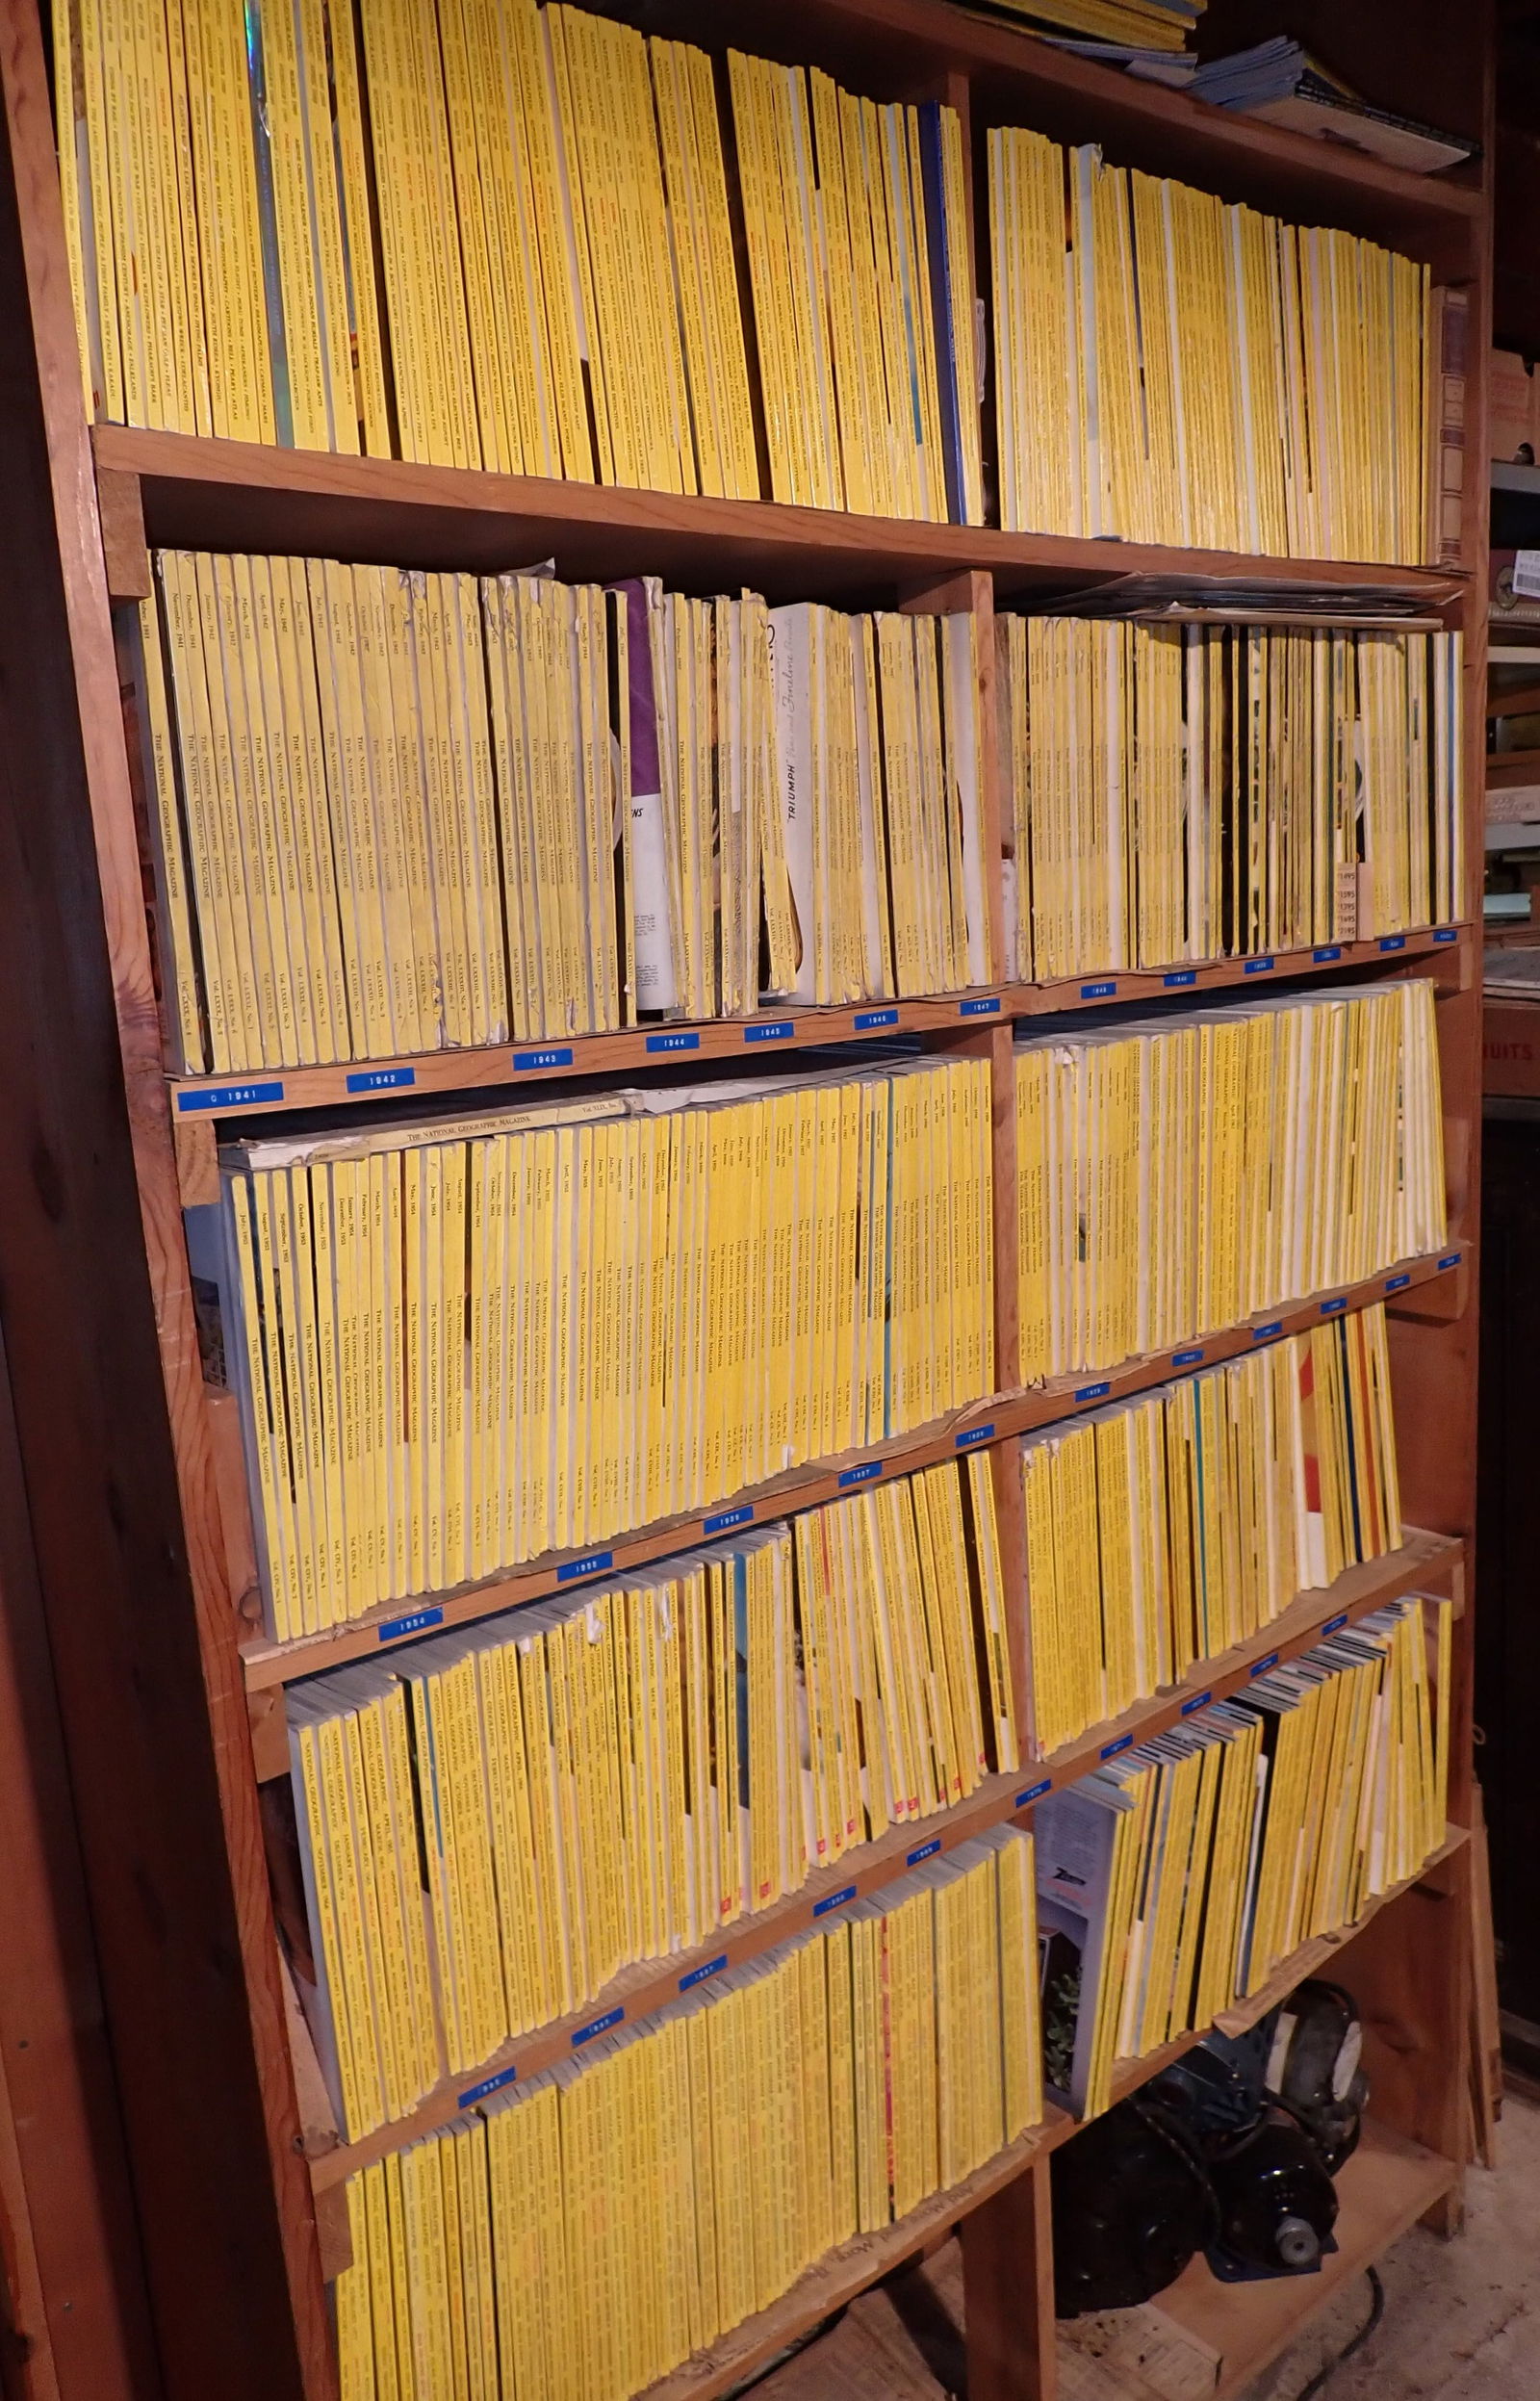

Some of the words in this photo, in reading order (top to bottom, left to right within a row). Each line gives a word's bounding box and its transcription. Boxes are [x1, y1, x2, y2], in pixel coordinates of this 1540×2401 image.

[171, 592, 181, 629] November,
[294, 755, 303, 794] NATIONAL
[189, 755, 199, 795] NATIONAL
[194, 800, 205, 852] GEOGRAPHIC
[200, 856, 210, 898] MAGAZINE
[256, 756, 266, 796] NATIONAL
[262, 800, 271, 850] GEOGRAPHIC
[267, 855, 275, 896] MAGAZINE
[298, 798, 309, 848] GEOGRAPHIC
[303, 852, 313, 892] MAGAZINE
[533, 1055, 556, 1064] 1943
[664, 1039, 684, 1047] 1944
[229, 1090, 256, 1100] 1941
[370, 1074, 395, 1085] 1942
[423, 1128, 456, 1140] NATIONAL
[458, 1123, 498, 1134] GEOGRAPHIC
[499, 1117, 531, 1126] MAGAZINE
[303, 1742, 314, 1781] NATIONAL
[309, 1786, 321, 1836] GEOGRAPHIC
[332, 1731, 341, 1769] NATIONAL
[337, 1773, 347, 1823] GEOGRAPHIC
